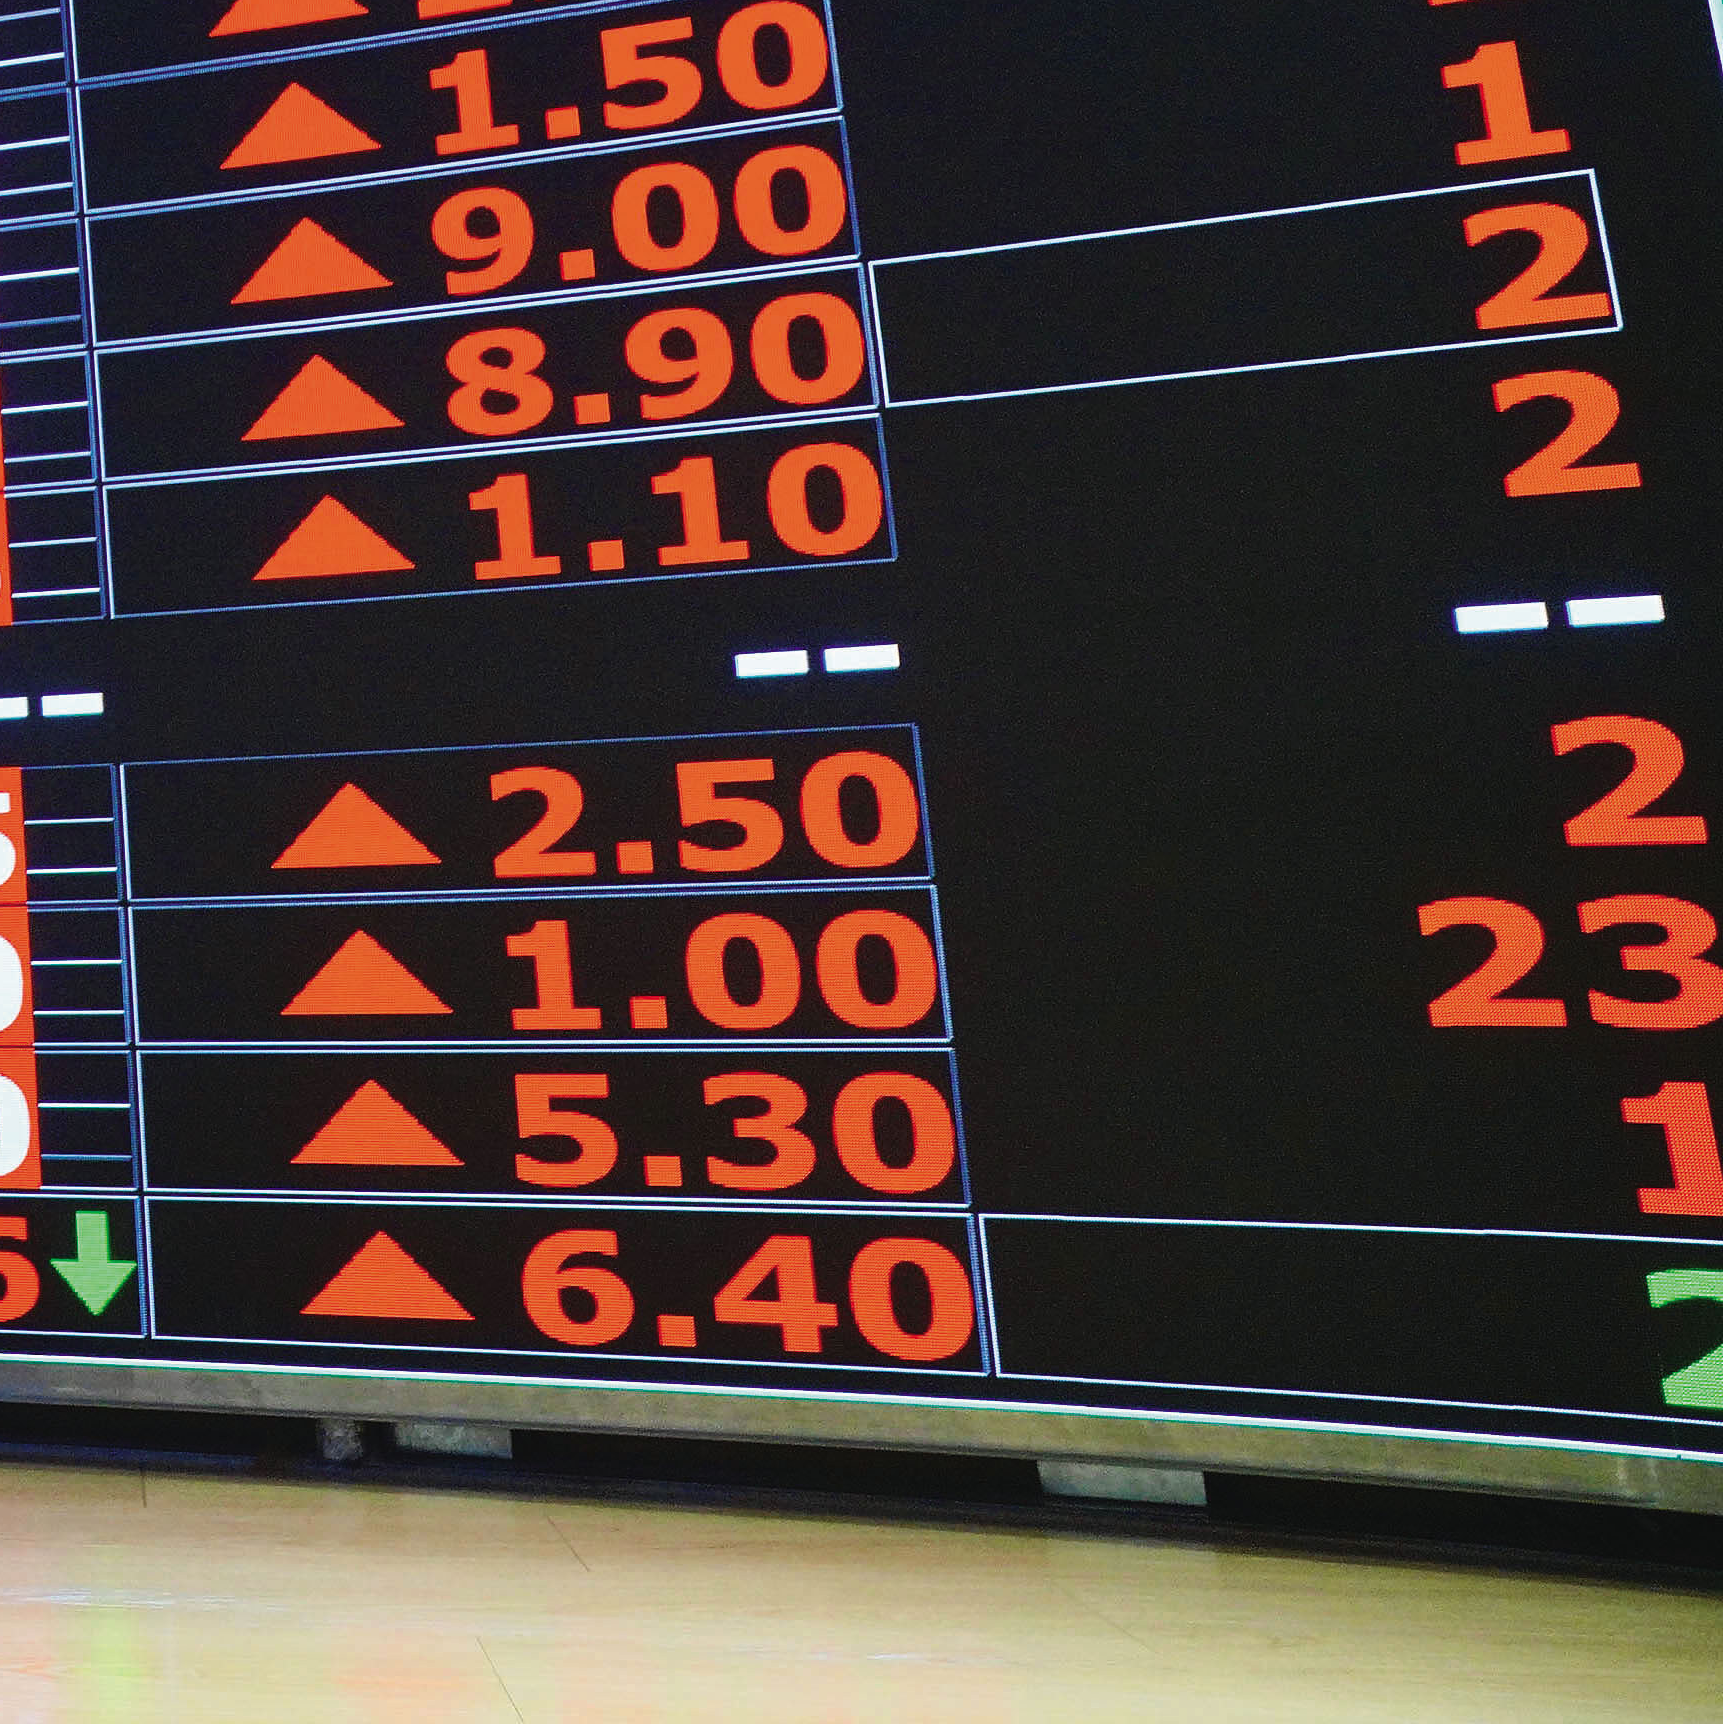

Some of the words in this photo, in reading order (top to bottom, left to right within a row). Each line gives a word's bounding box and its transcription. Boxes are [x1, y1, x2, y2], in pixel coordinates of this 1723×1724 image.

[431, 145, 846, 296] 9.00
[446, 292, 864, 436] 8.90
[469, 443, 882, 580] 1.10
[515, 1072, 955, 1194] 5.30
[522, 1230, 974, 1361] 6.40
